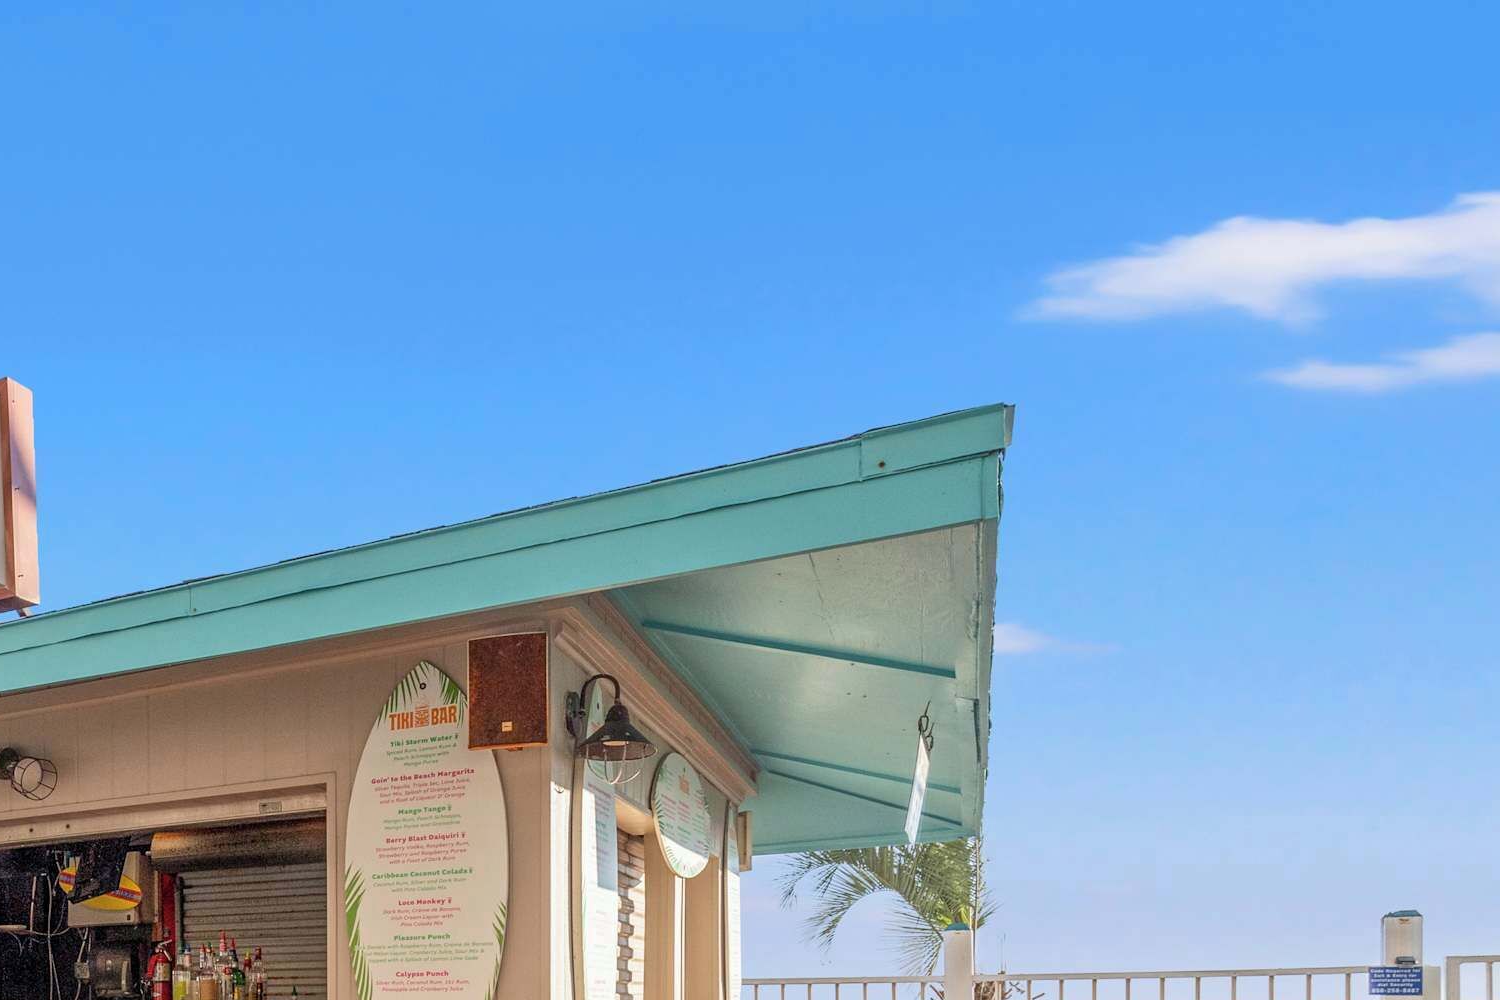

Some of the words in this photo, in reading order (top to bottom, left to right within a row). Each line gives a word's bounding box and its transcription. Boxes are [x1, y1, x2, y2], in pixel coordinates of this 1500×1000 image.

[389, 712, 413, 731] TIKI
[431, 705, 457, 725] BAR
[390, 740, 404, 748] Tiki
[405, 738, 428, 746] Storm
[371, 777, 390, 785] Goin'
[413, 772, 436, 780] Beach
[437, 768, 475, 778] Margarita
[398, 807, 422, 815] Mango
[423, 805, 446, 813] Tango
[408, 835, 427, 843] Blast
[429, 832, 459, 841] Daiquiri
[372, 872, 409, 880] Caribbean
[410, 869, 440, 878] Coconut
[442, 868, 469, 876] Colada
[416, 898, 446, 906] Monkey
[395, 971, 425, 980] Calypso
[426, 970, 449, 978] Punch
